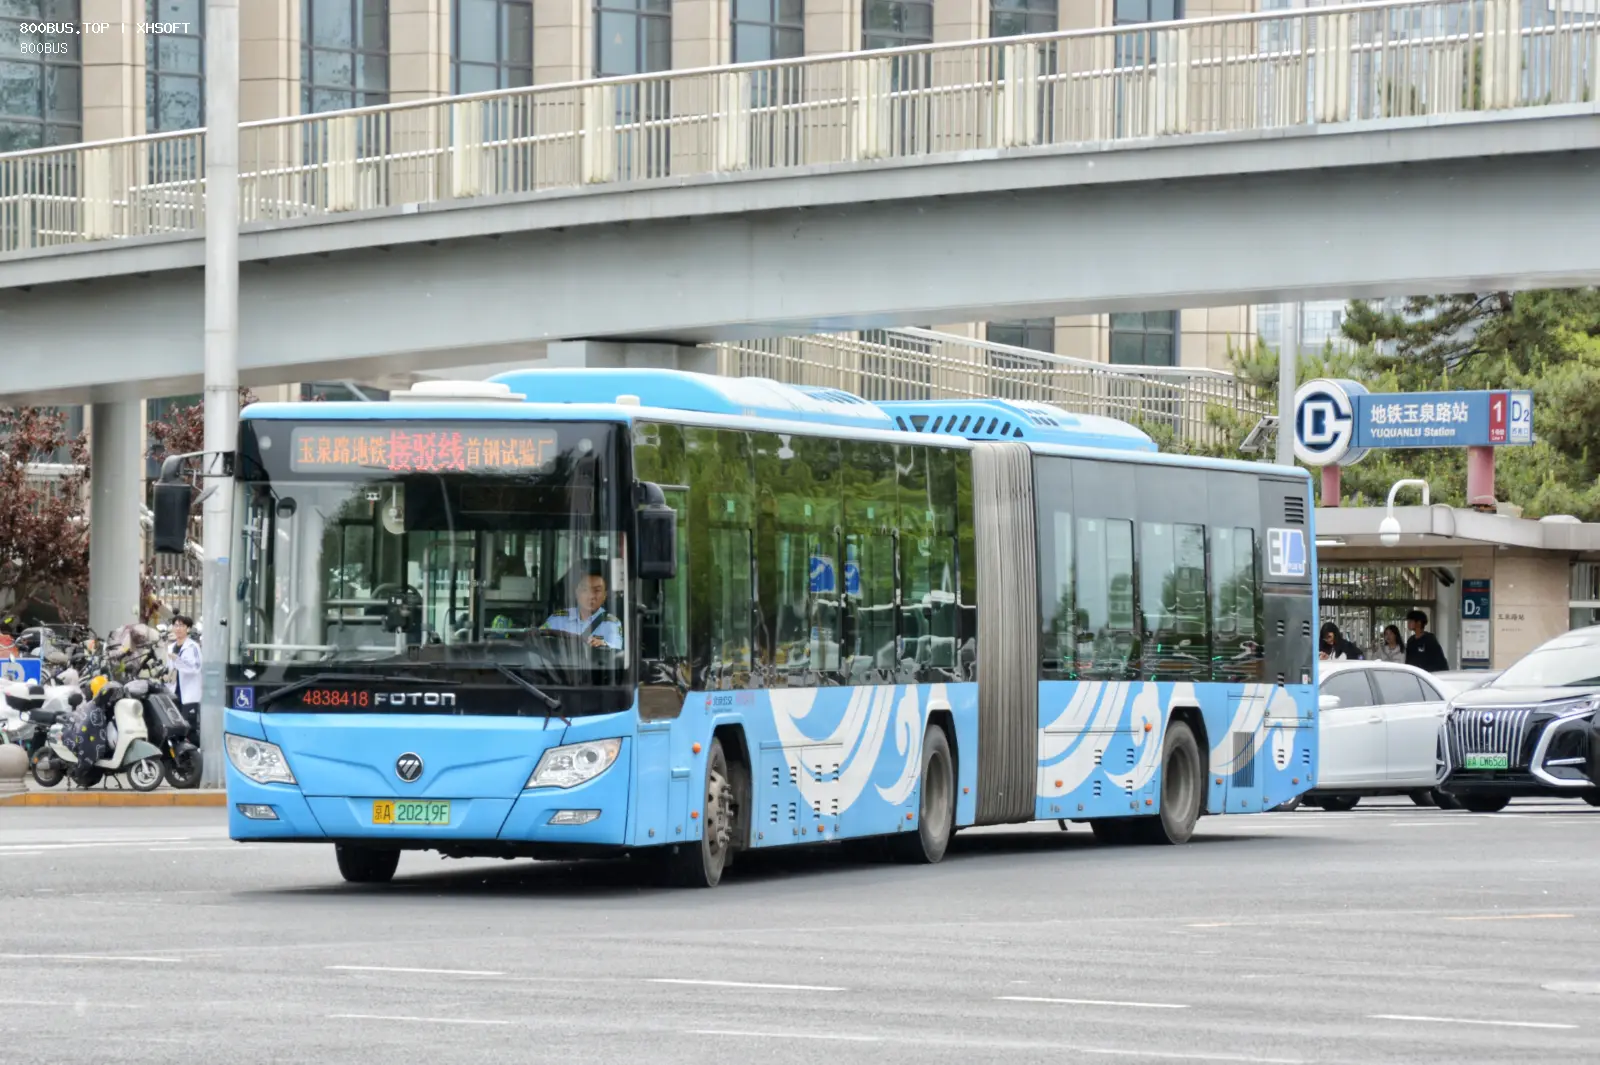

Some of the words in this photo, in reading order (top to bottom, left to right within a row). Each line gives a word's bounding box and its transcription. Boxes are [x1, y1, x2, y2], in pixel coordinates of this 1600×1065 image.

[1370, 401, 1469, 424] 地铁玉泉路站
[1492, 400, 1502, 422] 1
[1370, 427, 1422, 438] YUQUANLU
[1424, 426, 1456, 437] Station
[302, 690, 369, 707] 4838418
[374, 692, 456, 706] FOTON
[397, 804, 448, 821] 20219F
